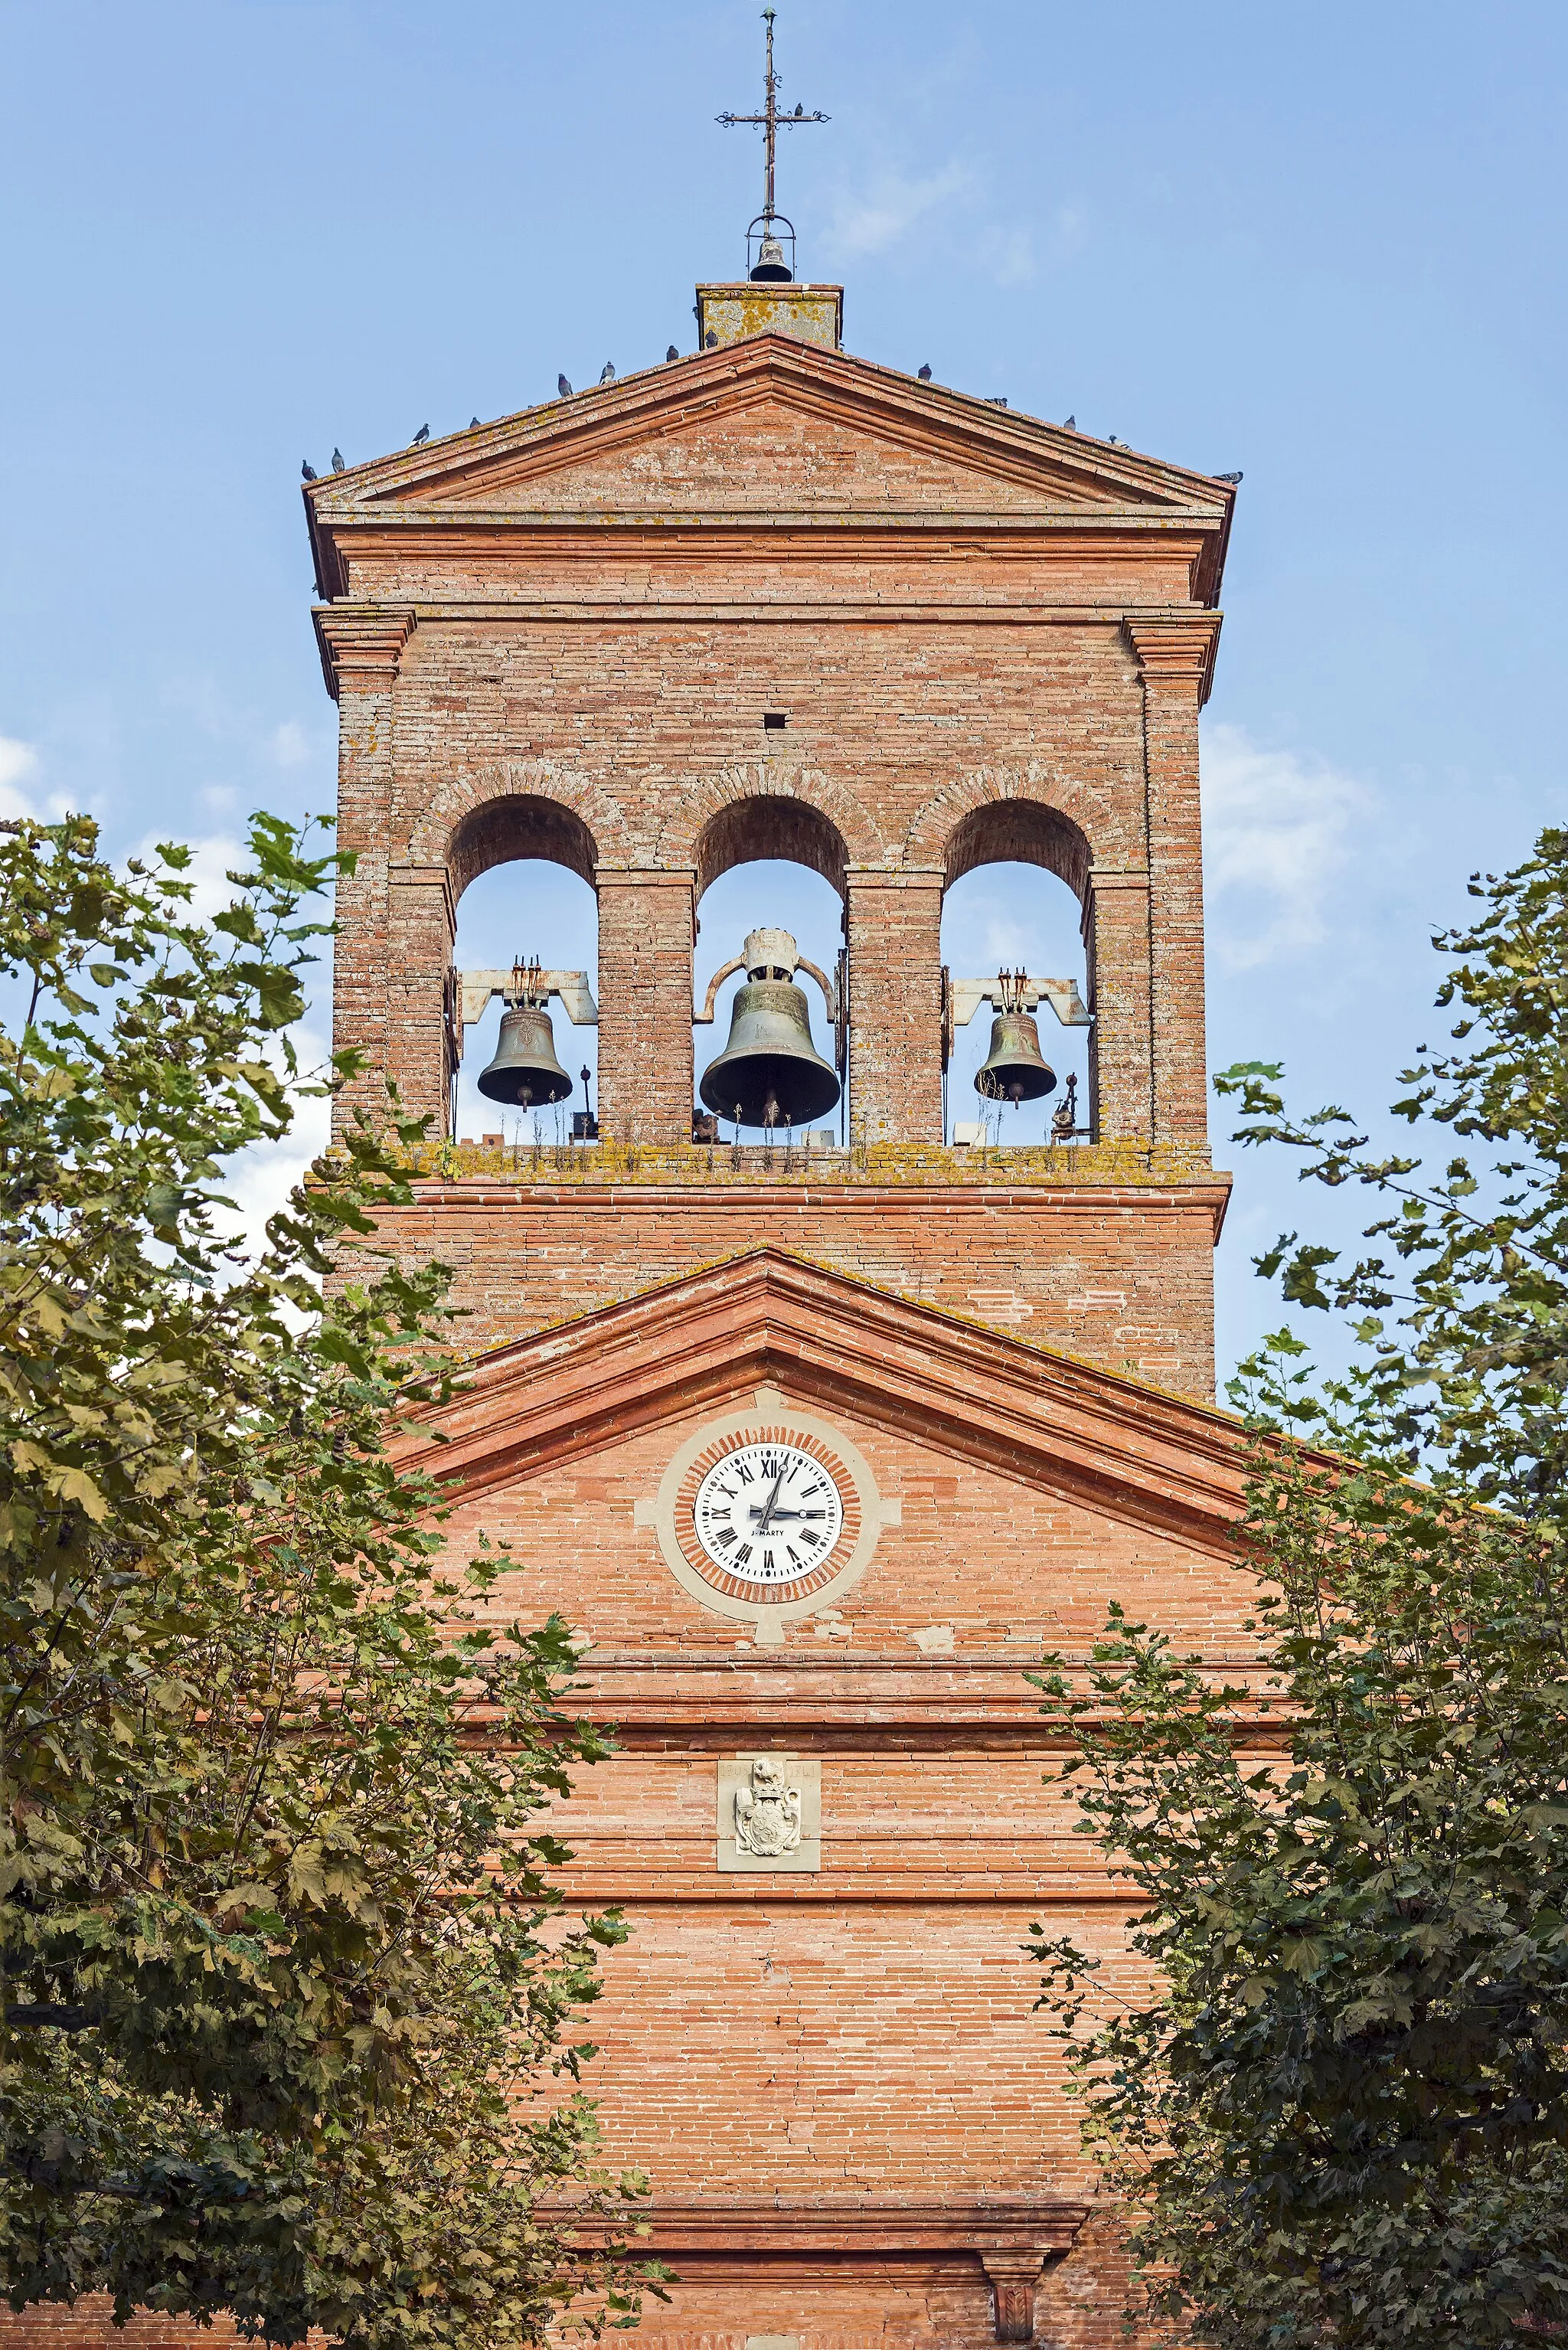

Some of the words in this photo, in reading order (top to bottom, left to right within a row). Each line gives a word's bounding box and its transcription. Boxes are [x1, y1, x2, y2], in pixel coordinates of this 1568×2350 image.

[735, 1464, 755, 1486] XI
[760, 1459, 777, 1479] XII
[786, 1466, 799, 1484] I
[717, 1483, 739, 1500] X
[800, 1484, 820, 1499] II
[711, 1507, 731, 1520] IX
[806, 1509, 826, 1519] III
[715, 1526, 739, 1549] VIII
[799, 1528, 821, 1547] IIII
[735, 1542, 753, 1564] VII
[764, 1550, 775, 1569] VI
[786, 1544, 800, 1563] V
